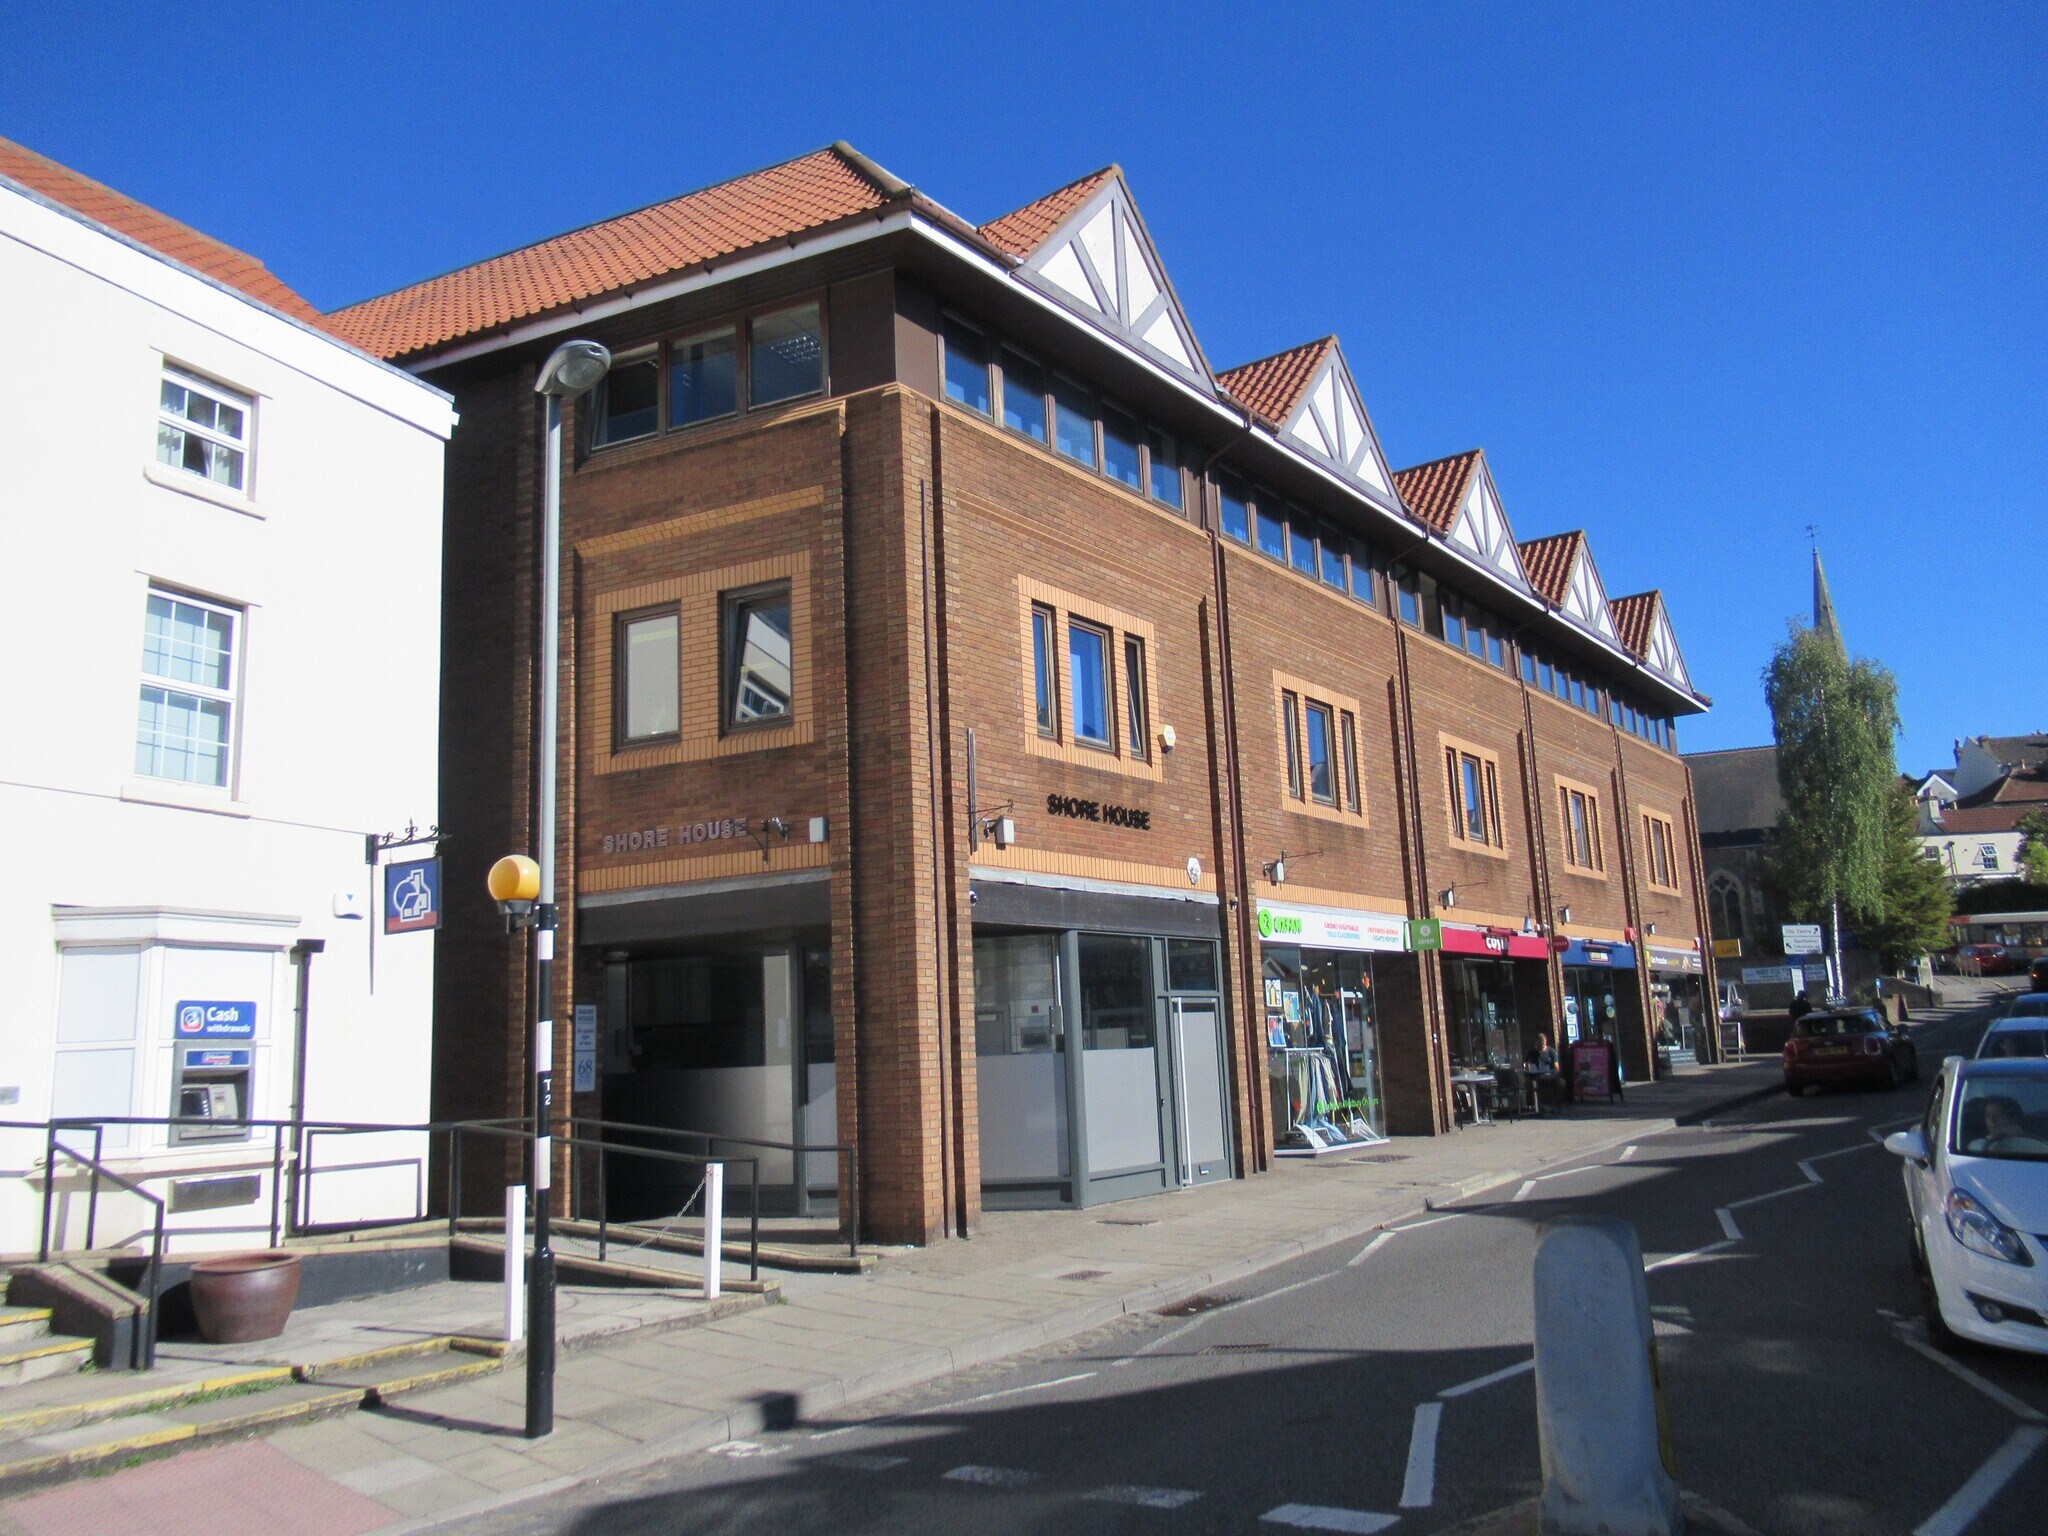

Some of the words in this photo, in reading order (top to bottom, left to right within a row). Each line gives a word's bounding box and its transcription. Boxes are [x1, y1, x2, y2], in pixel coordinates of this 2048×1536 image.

[1047, 793, 1100, 821] SHORE
[1102, 804, 1150, 830] HOUSE
[603, 828, 668, 854] SHORE
[679, 818, 748, 845] HOUSE
[206, 1006, 239, 1022] Cash
[206, 1024, 251, 1033] withdrawals
[578, 1060, 592, 1075] 68
[543, 1078, 552, 1091] T
[545, 1094, 552, 1105] 2
